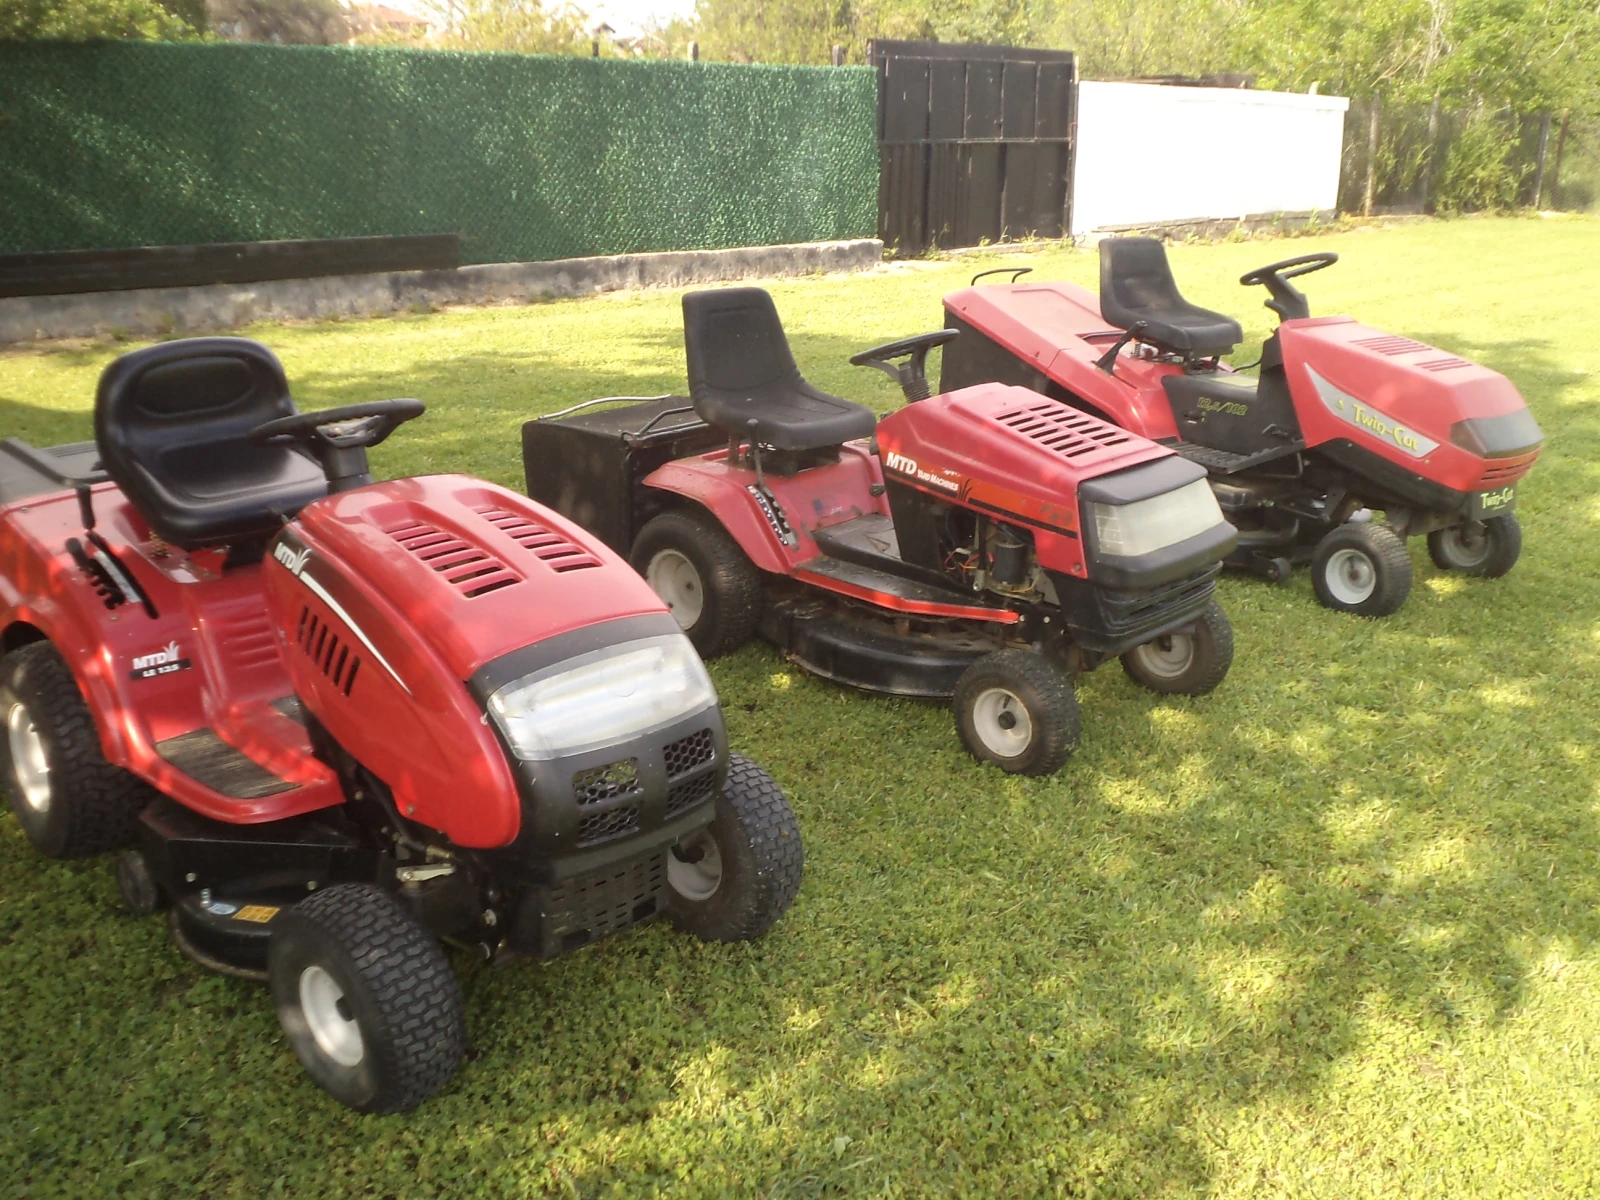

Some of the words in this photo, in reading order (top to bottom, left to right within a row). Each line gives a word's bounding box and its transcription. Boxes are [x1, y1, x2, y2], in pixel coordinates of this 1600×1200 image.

[1352, 403, 1419, 452] Twin-Cut
[886, 451, 918, 475] MTD
[273, 541, 298, 570] MTD
[132, 652, 167, 670] MTD
